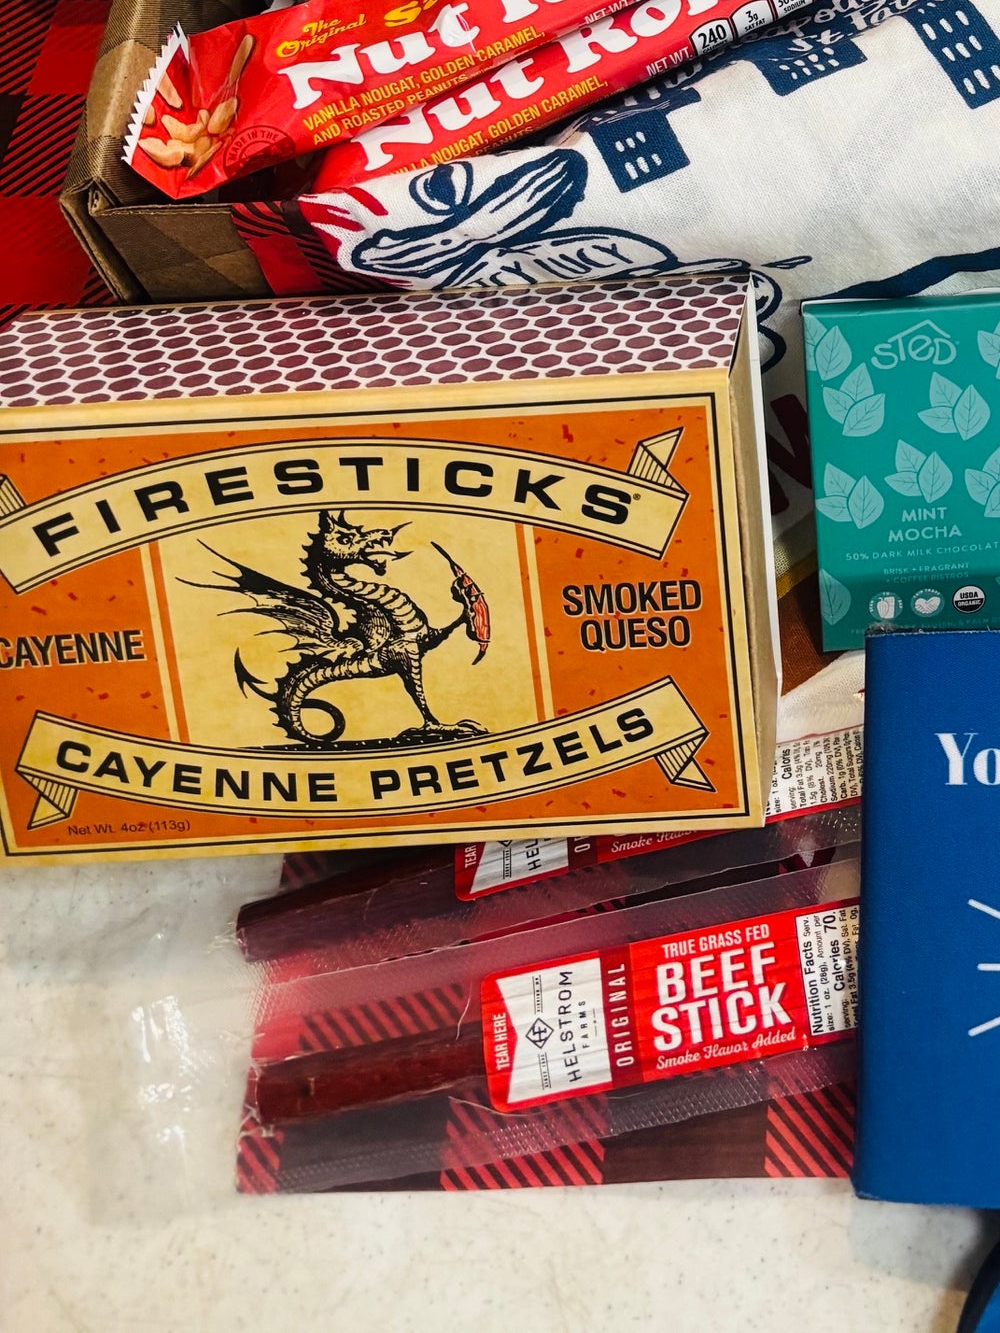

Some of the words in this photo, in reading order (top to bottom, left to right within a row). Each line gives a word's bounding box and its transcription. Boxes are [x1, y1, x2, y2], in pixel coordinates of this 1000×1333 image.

[278, 3, 480, 109] Nut
[698, 25, 727, 49] 240
[303, 91, 360, 131] VANILLA
[359, 74, 421, 109] NOUGAT,
[420, 53, 476, 92] GOLDEN
[355, 54, 562, 172] Nut
[313, 124, 342, 145] AND
[344, 100, 405, 129] ROASTED
[488, 107, 542, 145] GOLDEN
[34, 456, 631, 558] FIRESTICKS
[901, 507, 947, 522] MINT
[888, 525, 962, 543] MOCHA
[562, 580, 701, 616] SMOKED
[581, 614, 691, 651] QUESO
[56, 738, 338, 804] CAYENNE
[371, 706, 654, 802] PRETZELS
[662, 942, 696, 960] TRUE
[699, 931, 743, 953] GRASS
[745, 924, 770, 940] FED
[656, 942, 777, 1005] BEEF
[494, 1012, 506, 1041] HERE
[558, 970, 582, 1083] HELSTROM
[611, 963, 635, 1067] ORIGINAL
[651, 982, 791, 1052] STICK
[808, 980, 823, 1034] Nutrition
[496, 1041, 511, 1070] TEAR
[656, 1052, 701, 1070] Smoke
[751, 1028, 796, 1049] Added
